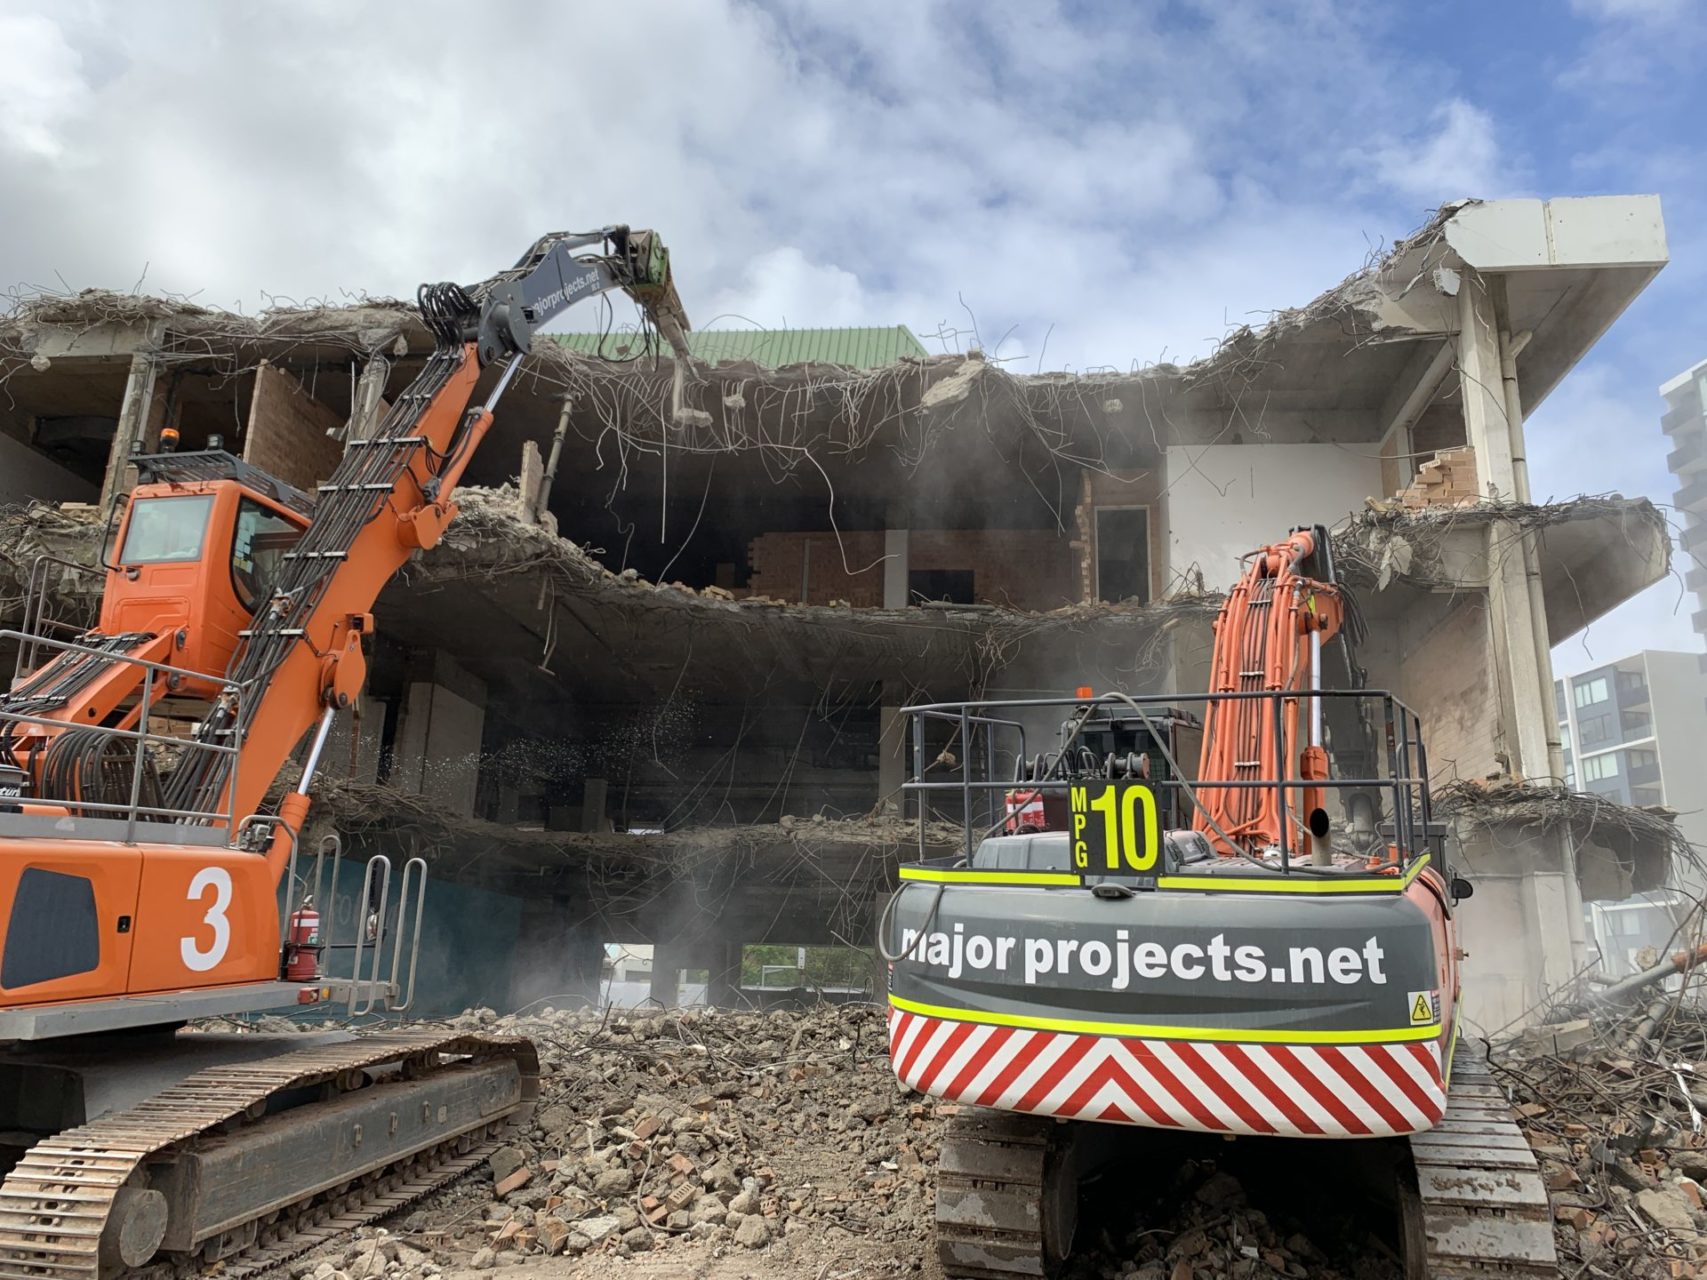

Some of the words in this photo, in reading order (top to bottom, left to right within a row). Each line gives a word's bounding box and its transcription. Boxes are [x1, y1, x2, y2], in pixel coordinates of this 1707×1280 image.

[1091, 784, 1159, 871] 10
[180, 866, 233, 971] 3
[901, 923, 1017, 979] major
[1024, 930, 1387, 989] projects.net
